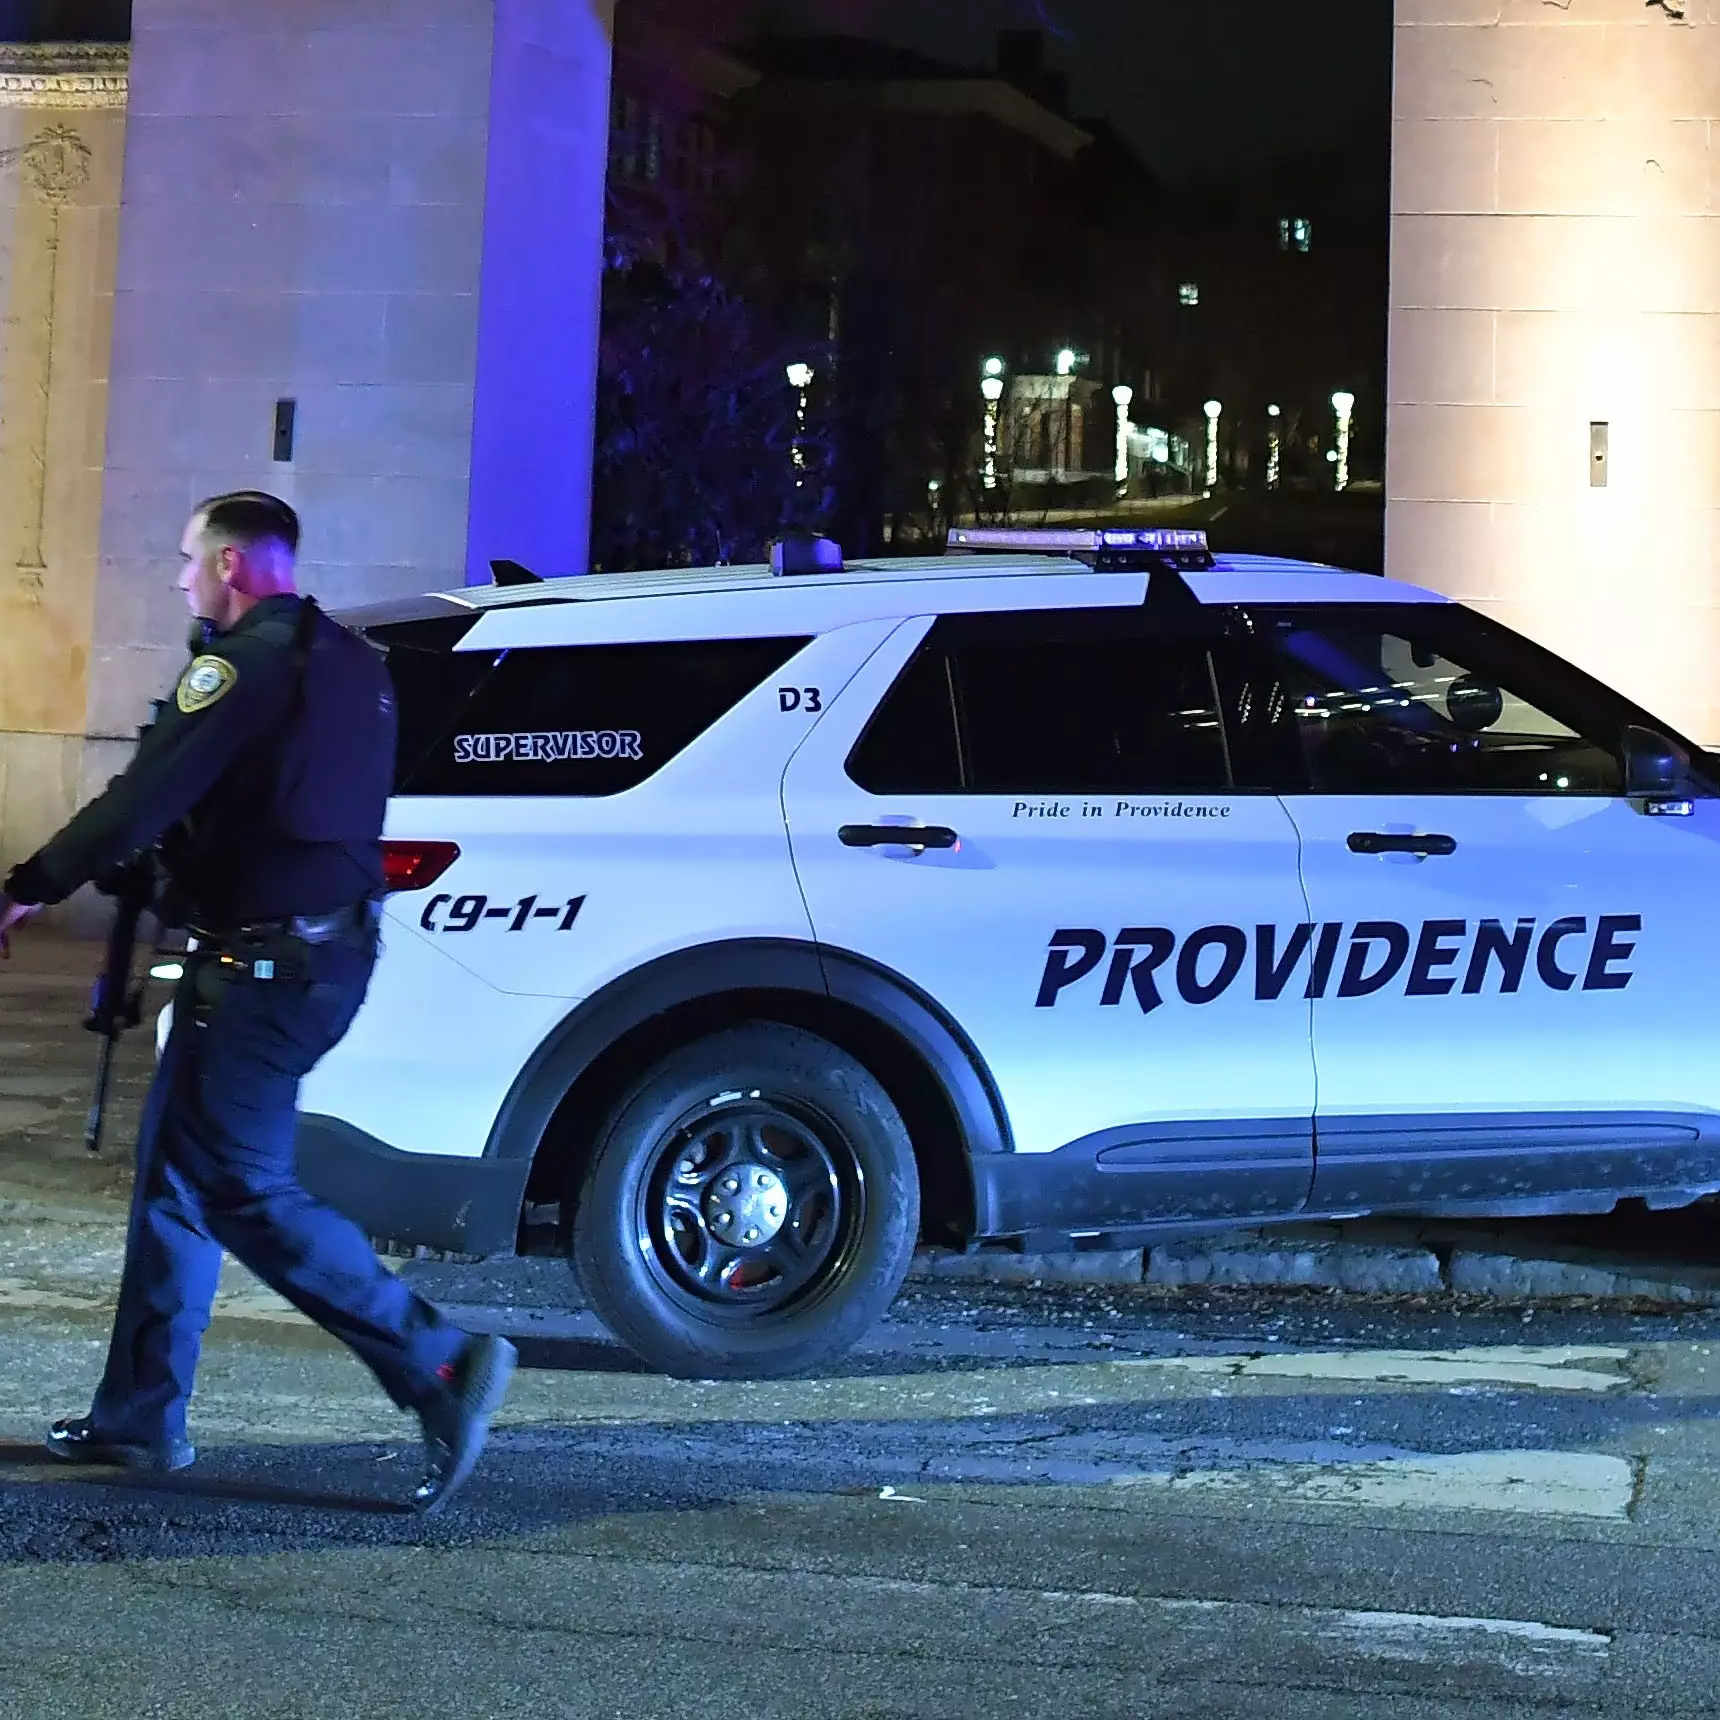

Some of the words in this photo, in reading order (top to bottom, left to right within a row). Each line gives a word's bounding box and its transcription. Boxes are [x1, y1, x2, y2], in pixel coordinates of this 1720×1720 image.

[778, 687, 822, 713] D3
[453, 730, 643, 762] SUPERVISOR
[1012, 802, 1071, 819] Pride
[1082, 802, 1102, 817] in
[1114, 802, 1231, 818] Providence
[1035, 914, 1642, 1014] PROVIDENCE
